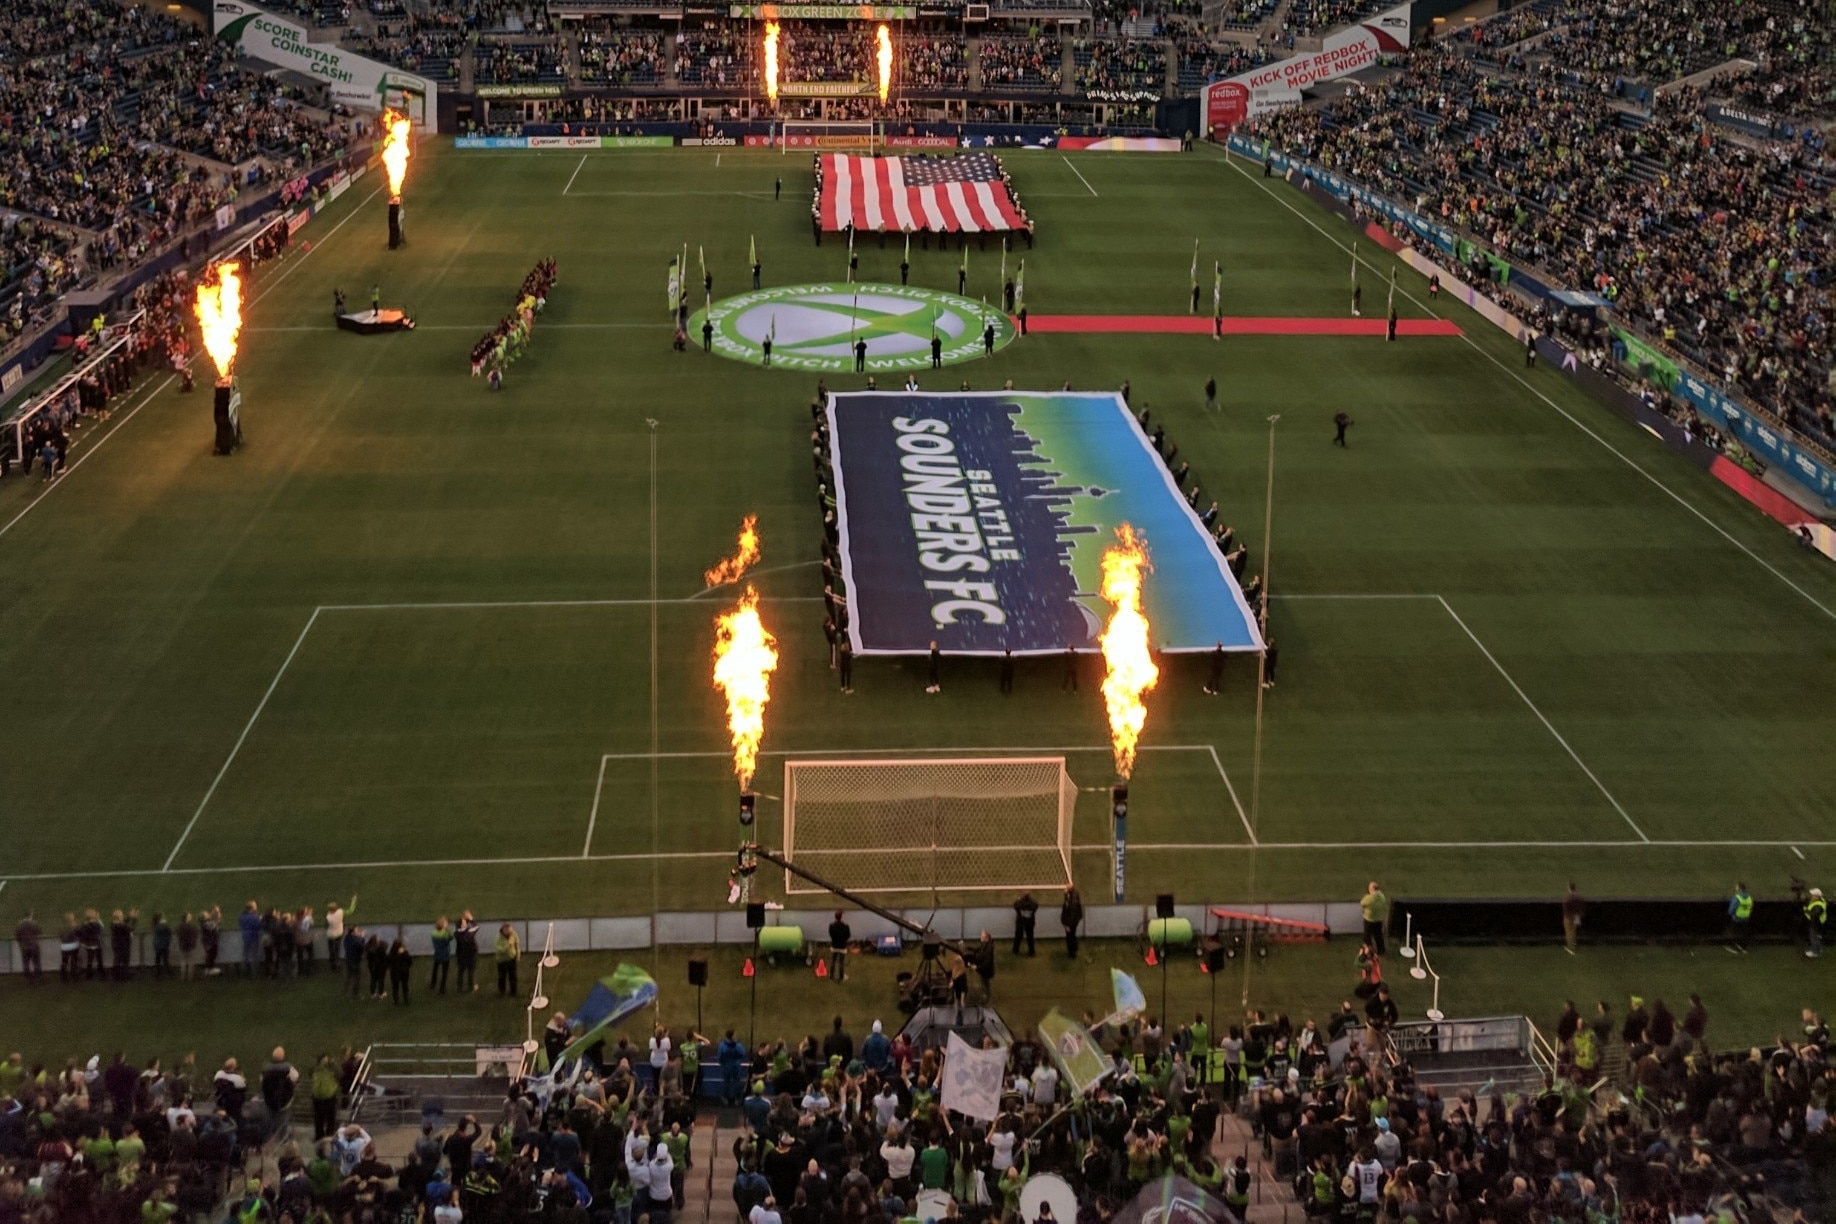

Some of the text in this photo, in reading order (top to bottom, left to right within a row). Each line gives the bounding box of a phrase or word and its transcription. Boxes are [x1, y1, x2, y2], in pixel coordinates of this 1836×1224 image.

[802, 7, 843, 18] GREEN
[254, 19, 300, 42] SCORE
[271, 37, 339, 66] COINSTAR
[310, 62, 353, 83] CASH!
[1250, 40, 1367, 88] KICK OFF REDBOX
[1287, 49, 1378, 89] MOVIE NIGHT!
[478, 87, 510, 95] WELCOME
[782, 84, 859, 93] NORTH END FAITHFUL
[1211, 87, 1241, 99] redbox
[703, 137, 736, 146] adidas
[724, 286, 833, 308] WELCOME
[860, 285, 932, 298] PITCH
[892, 416, 991, 572] SOUNDERS
[966, 469, 1021, 561] SEATTLE
[1116, 840, 1125, 894] SEATTLE
